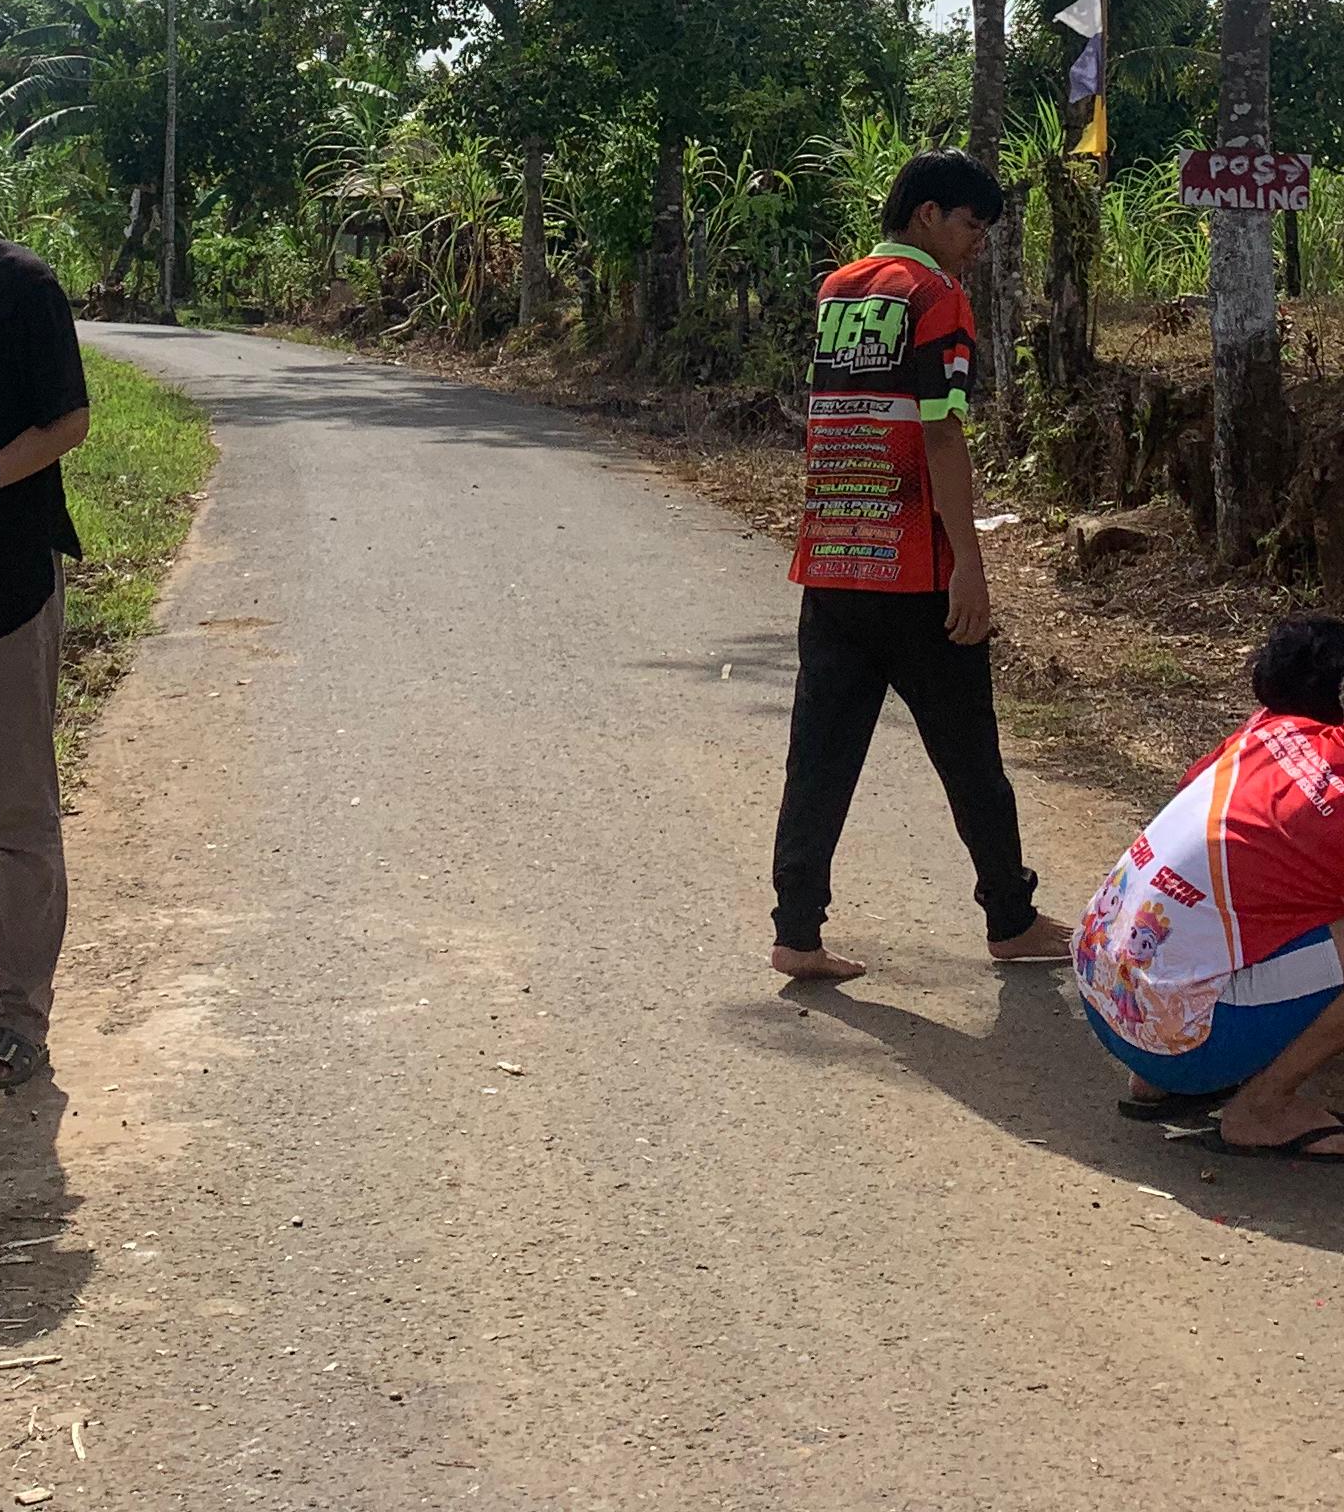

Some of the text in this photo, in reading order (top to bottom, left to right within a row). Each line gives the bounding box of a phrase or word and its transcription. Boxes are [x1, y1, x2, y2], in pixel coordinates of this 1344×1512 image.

[1208, 153, 1276, 186] POS
[1183, 184, 1309, 211] KAMLING
[817, 299, 906, 354] 464
